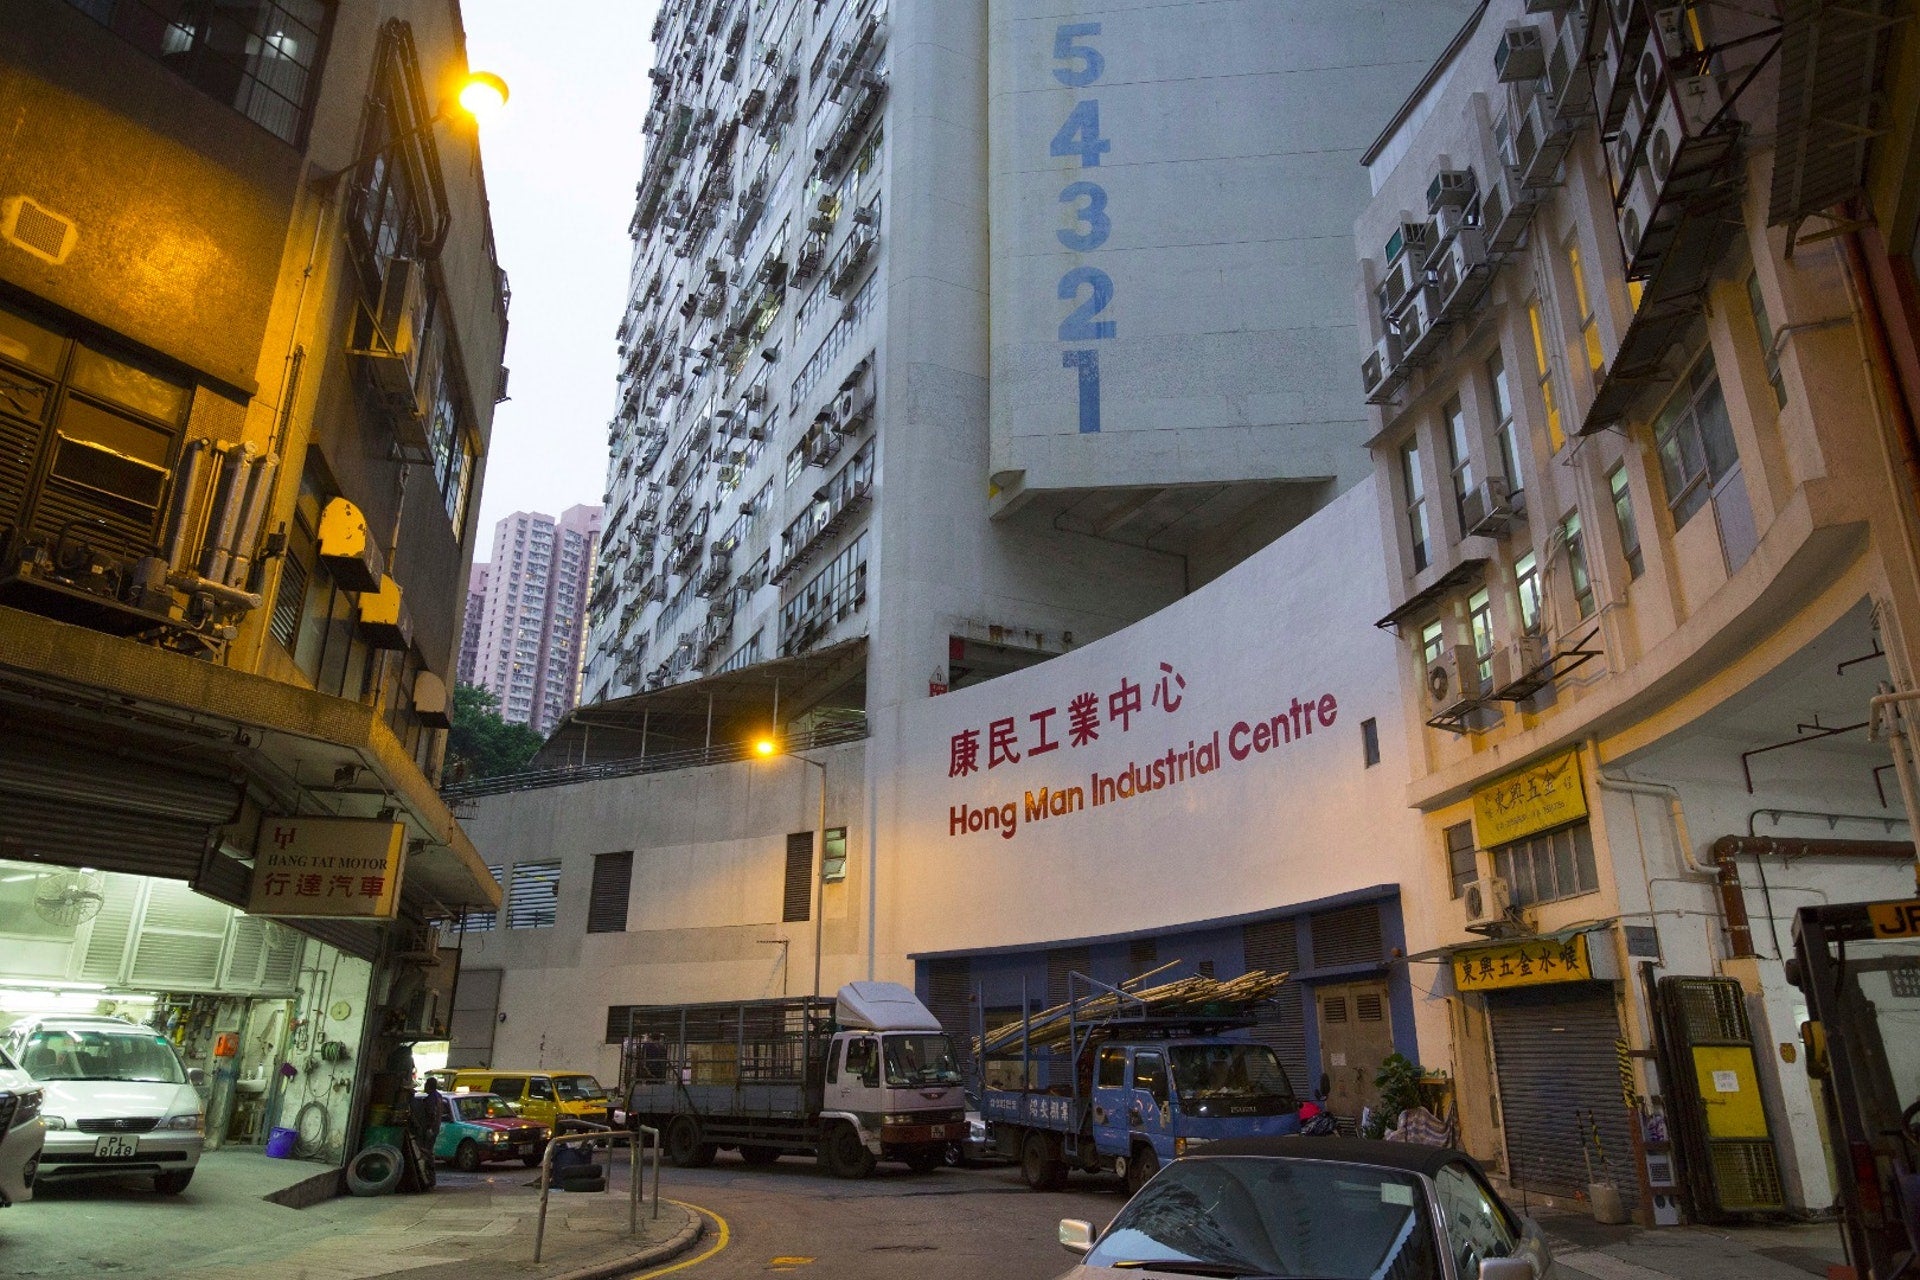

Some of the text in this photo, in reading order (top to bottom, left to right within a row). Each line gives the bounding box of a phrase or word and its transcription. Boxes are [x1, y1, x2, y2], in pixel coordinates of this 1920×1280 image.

[1052, 22, 1105, 88] 5
[1050, 100, 1111, 168] 4
[1056, 181, 1112, 253] 3
[1057, 266, 1117, 341] 2
[1062, 349, 1101, 434] 1
[947, 662, 1186, 778] 康民工業中心
[949, 693, 1338, 839] Hong Man Industrial Centre
[1494, 767, 1556, 815] 東興五金
[264, 872, 386, 899] 行達汽車
[268, 855, 388, 870] HANG TAT MOTOR
[1462, 945, 1580, 985] 東興五金水喉
[100, 1146, 132, 1157] 8148
[109, 1136, 126, 1147] PL
